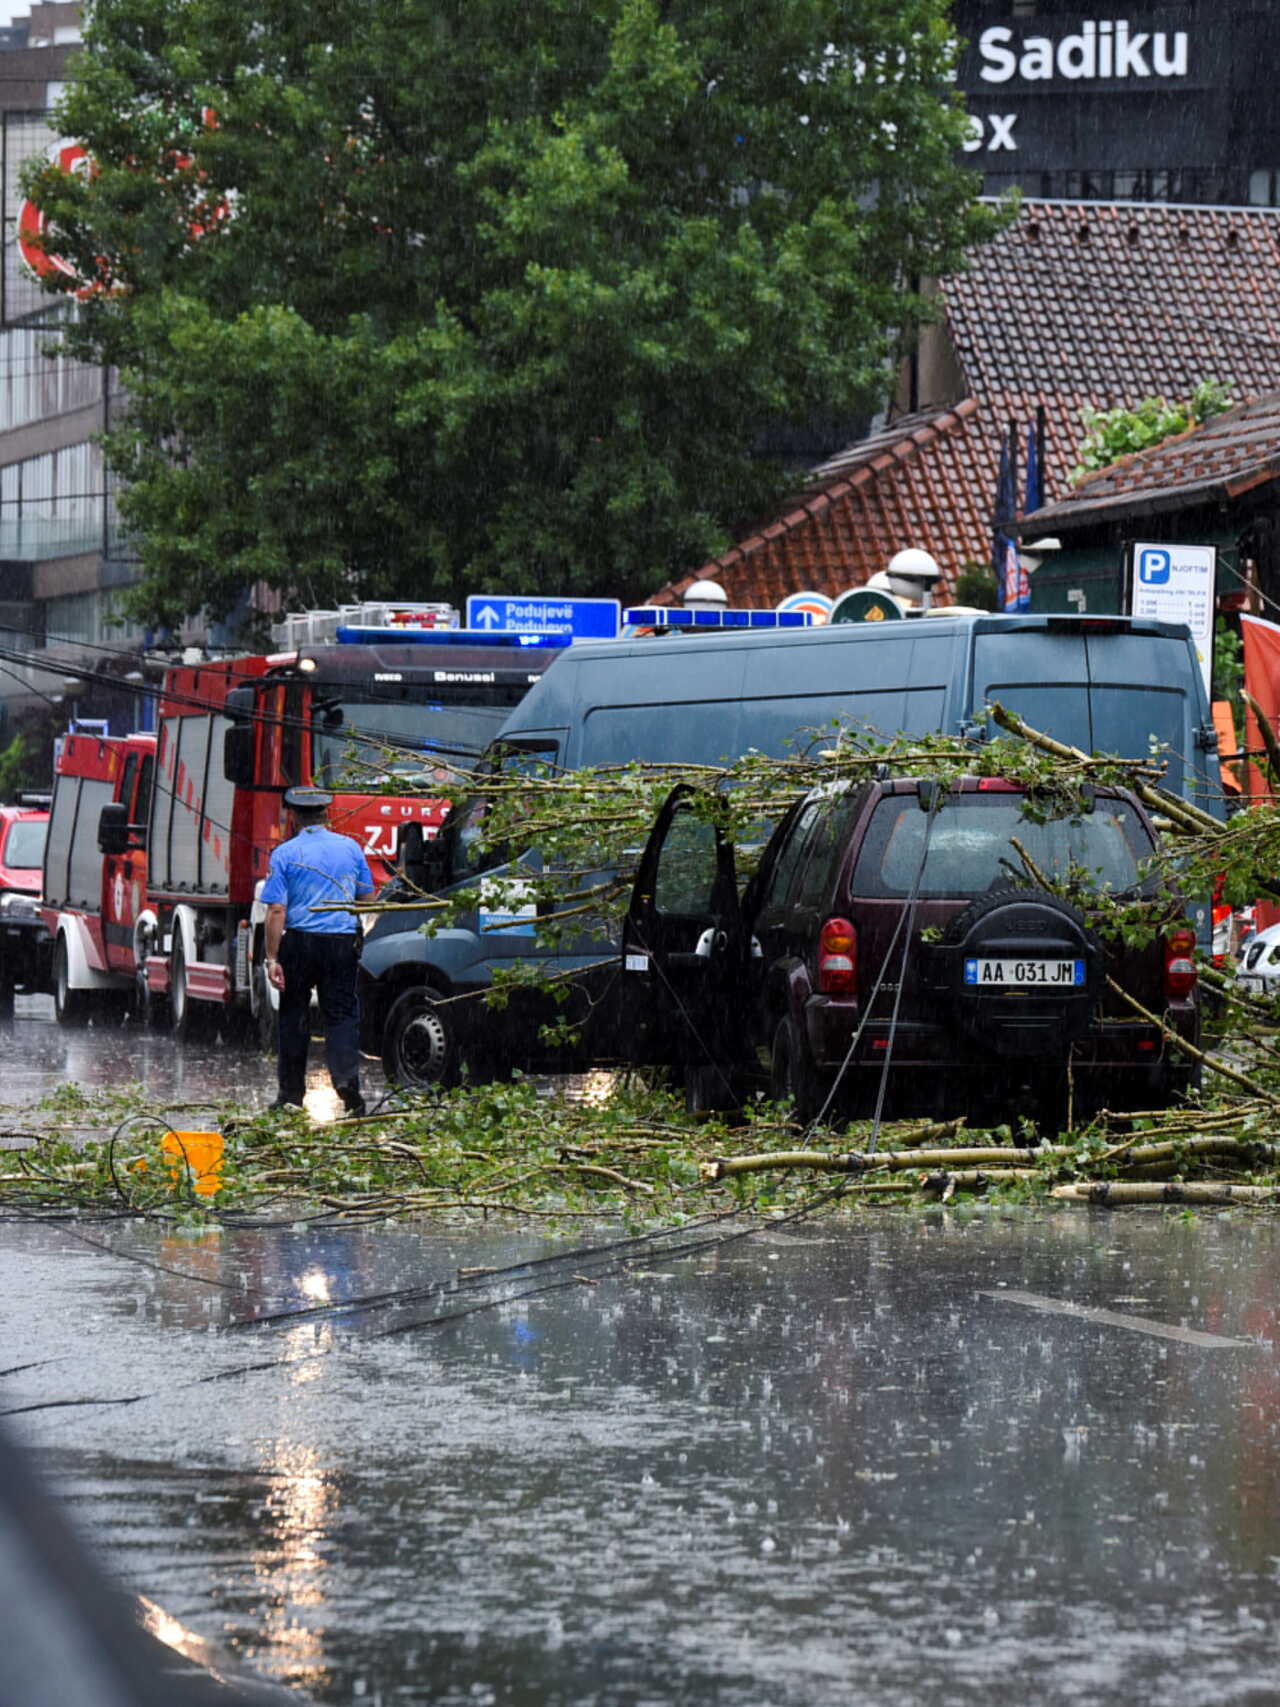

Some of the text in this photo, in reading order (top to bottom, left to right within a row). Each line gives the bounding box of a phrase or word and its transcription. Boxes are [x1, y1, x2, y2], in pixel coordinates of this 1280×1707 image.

[979, 20, 1189, 83] Sadiku
[505, 603, 573, 622] Podujevë
[982, 963, 1073, 983] AA 031 JM
